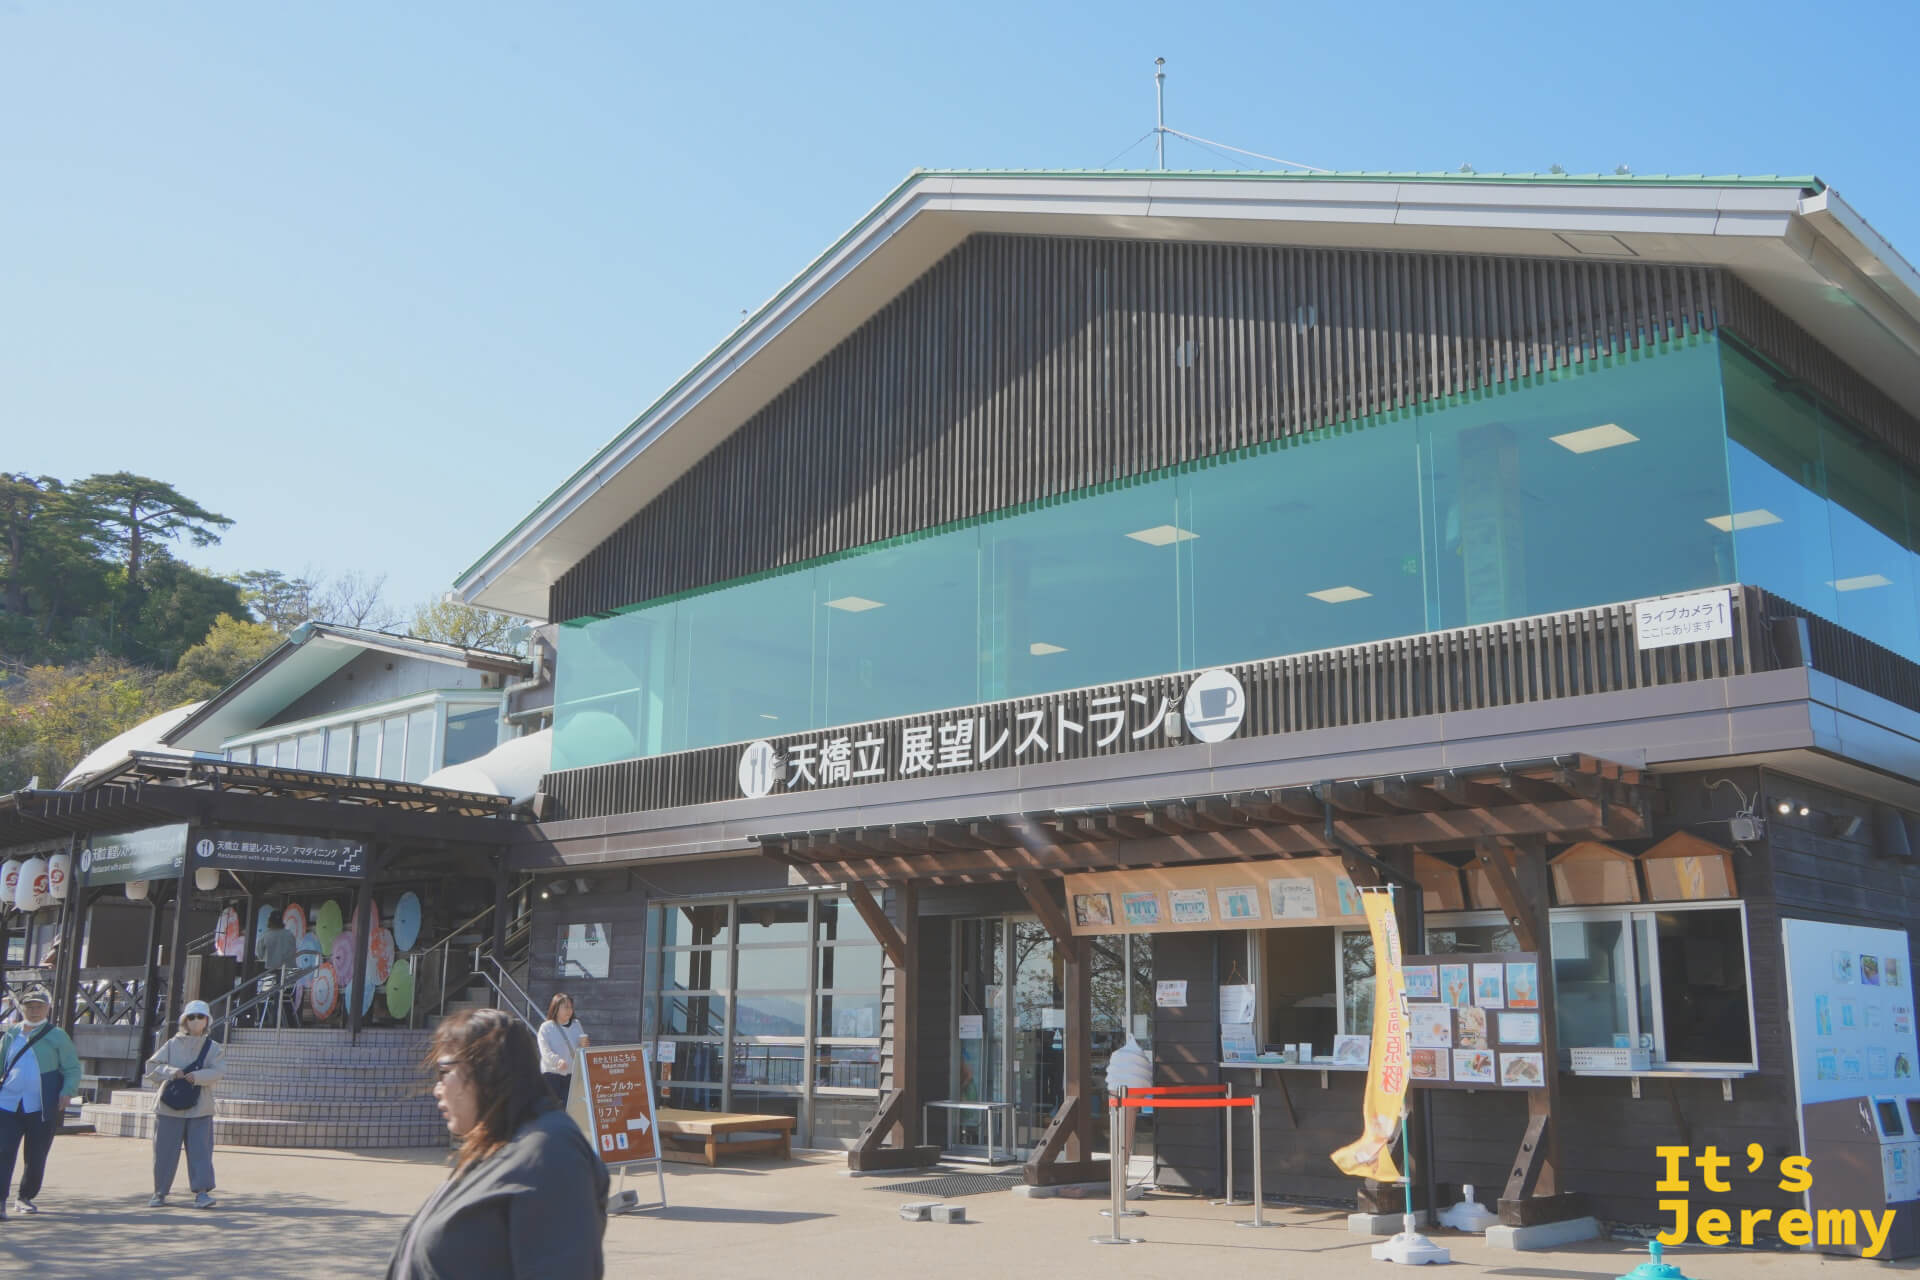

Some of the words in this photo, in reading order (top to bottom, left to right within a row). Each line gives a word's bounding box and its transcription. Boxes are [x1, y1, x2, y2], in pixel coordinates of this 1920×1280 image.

[1641, 603, 1713, 625] ライブカメラ
[1641, 620, 1713, 639] ここにあります
[786, 731, 885, 789] 天橋立
[899, 691, 1170, 776] 展望レストラン
[293, 846, 338, 858] アマダイニング
[350, 864, 361, 873] 2F
[595, 1080, 641, 1093] ケーブルカー
[598, 1106, 620, 1118] リフト
